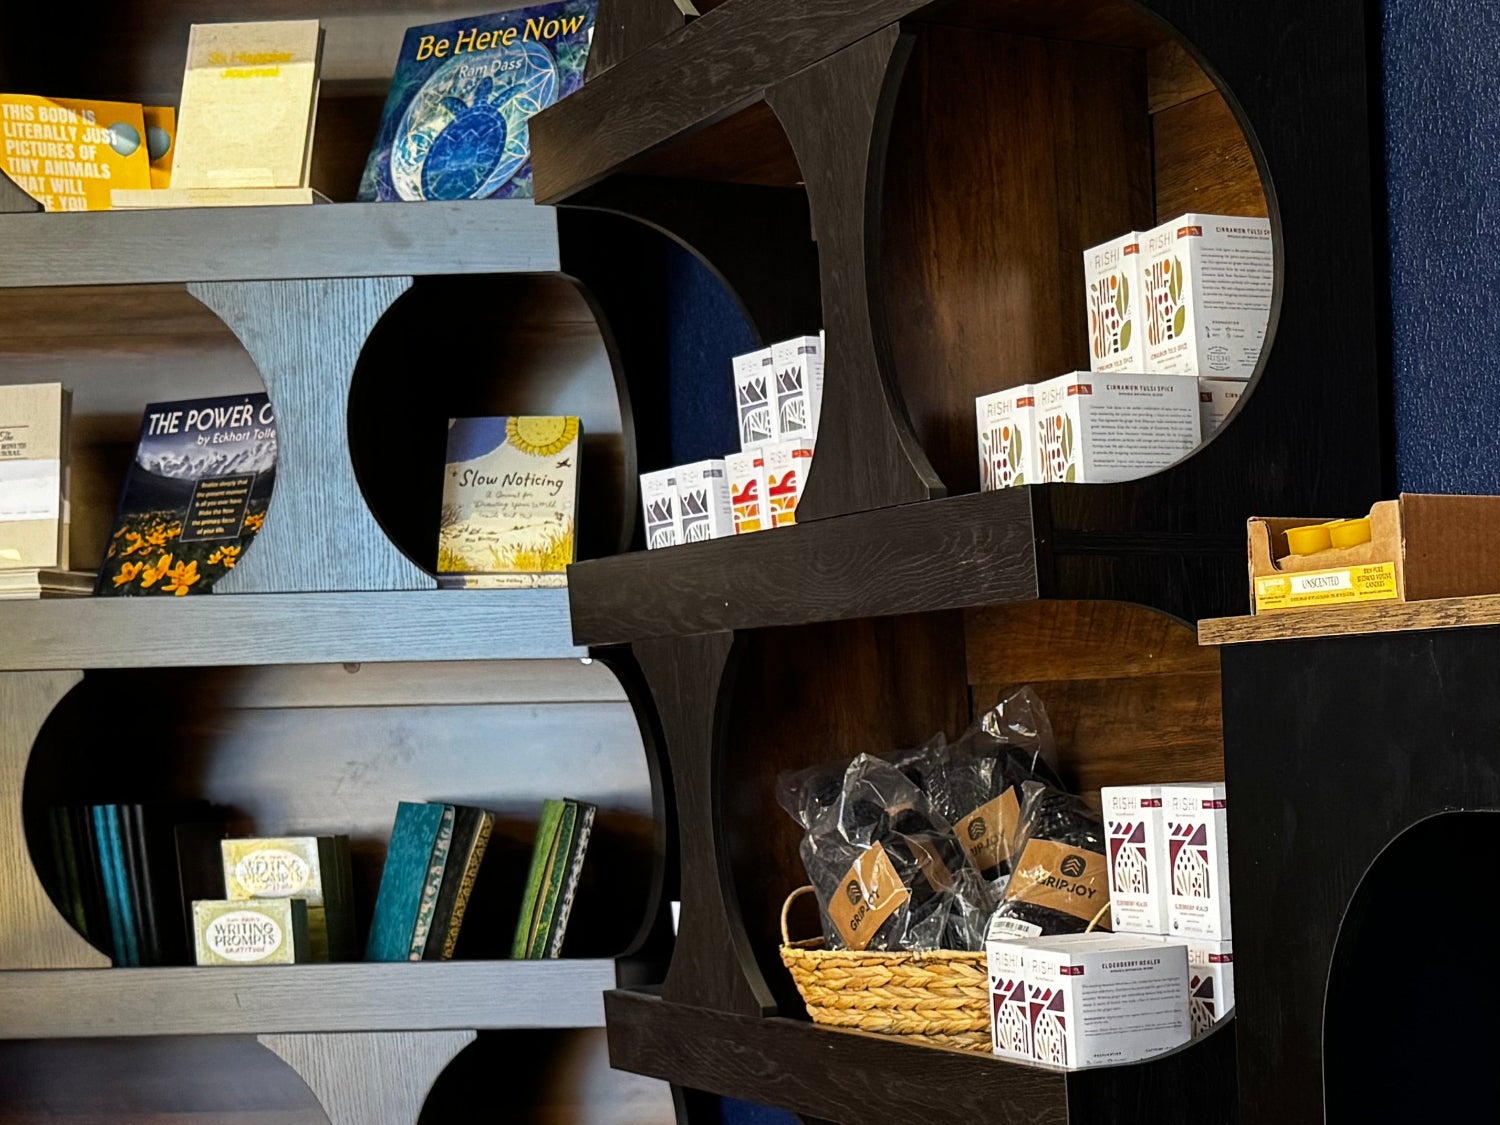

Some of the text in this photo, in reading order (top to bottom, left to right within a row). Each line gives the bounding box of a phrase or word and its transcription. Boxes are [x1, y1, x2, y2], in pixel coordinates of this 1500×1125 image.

[415, 15, 585, 61] Be Here Now
[458, 58, 524, 79] Ram Dass
[2, 103, 97, 127] THIS BOOK IS
[3, 120, 118, 146] LITERALLY JUST
[5, 138, 97, 161] PICTURES OF
[7, 156, 111, 179] TINY ANIMALS
[18, 175, 87, 195] HAT WILL
[58, 195, 88, 211] YOU
[1149, 231, 1174, 250] RISHI
[1094, 248, 1120, 267] RISHI
[1041, 386, 1065, 407] RISHI
[987, 399, 1013, 418] RISHI
[149, 402, 253, 436] THE POWER
[198, 434, 210, 446] by
[213, 430, 250, 445] Eckhart
[459, 468, 564, 497] Slow Noticing
[1301, 575, 1340, 590] UNSCENTED
[1112, 796, 1137, 810] RISHI
[1171, 797, 1198, 811] RISHI
[214, 923, 274, 936] WRITING
[214, 934, 275, 947] PROMPTS
[995, 952, 1019, 966] RISHI
[1032, 960, 1057, 976] RISHI
